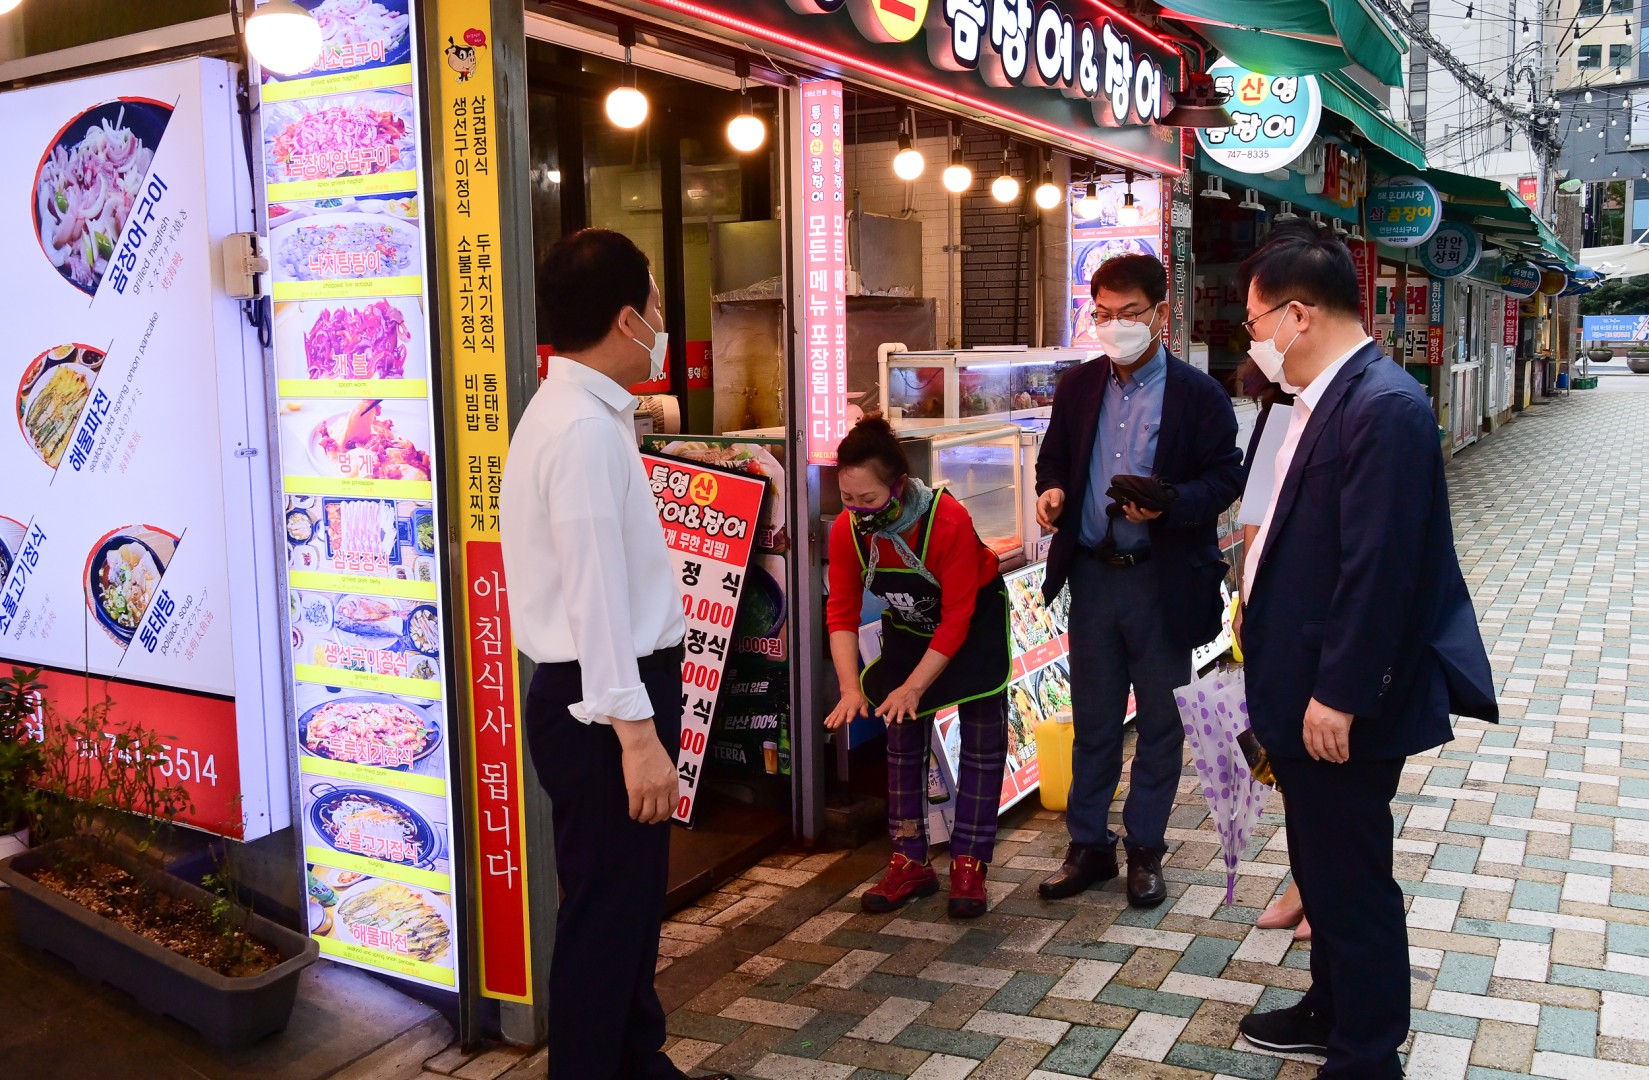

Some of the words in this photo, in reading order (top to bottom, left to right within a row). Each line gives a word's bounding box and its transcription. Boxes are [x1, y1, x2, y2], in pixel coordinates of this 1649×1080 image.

[1241, 77, 1264, 101] 산
[1271, 76, 1299, 103] 영
[471, 94, 488, 176] 삼겹정식
[809, 103, 823, 137] 통영
[290, 146, 392, 177] 곰장어양념구이
[452, 97, 471, 218] 생선구이정식
[811, 141, 823, 154] 산
[1227, 150, 1270, 159] 747-8335
[810, 156, 825, 203] 곰장어
[1370, 207, 1385, 222] 산
[1388, 205, 1432, 222] 곰장어
[109, 172, 169, 296] 곰장어구이
[807, 214, 828, 263] 모든
[833, 214, 843, 263] 모든
[1436, 236, 1463, 250] 함안
[133, 257, 151, 295] grilled
[150, 216, 171, 258] hagfish
[308, 252, 381, 276] 낙지탕탕이
[1434, 249, 1461, 265] 상회
[1513, 268, 1535, 279] 유명한
[457, 235, 477, 354] 소불고기정식
[476, 234, 495, 354] 두루치기정식
[809, 269, 829, 317] 메뉴
[104, 414, 116, 436] and
[113, 384, 130, 415] spring
[126, 355, 141, 384] onion
[138, 311, 160, 355] pancake
[810, 324, 832, 443] 포장됩니다
[465, 373, 480, 432] 비빔밥
[483, 373, 500, 433] 동태탕
[69, 387, 112, 472] 해물파전
[468, 455, 485, 532] 김치찌개
[694, 477, 714, 502] 산
[663, 527, 678, 546] 개
[678, 531, 701, 552] 무한
[0, 523, 47, 636] 소불고기정식
[331, 550, 390, 573] 삼겹정식
[14, 608, 31, 641] bulgogi
[139, 588, 175, 654] 동태탕
[160, 620, 180, 657] pollack
[178, 594, 194, 620] soup
[324, 643, 409, 673] 생선구이정식
[472, 569, 514, 747] 아침식사
[687, 628, 726, 661] 정식
[749, 714, 778, 730] 100%
[330, 738, 414, 770] 두루치기정식
[712, 745, 747, 764] TERRA
[480, 761, 519, 890] 됩니다
[334, 831, 420, 864] 소불고기정식
[352, 922, 409, 955] 해물파전
